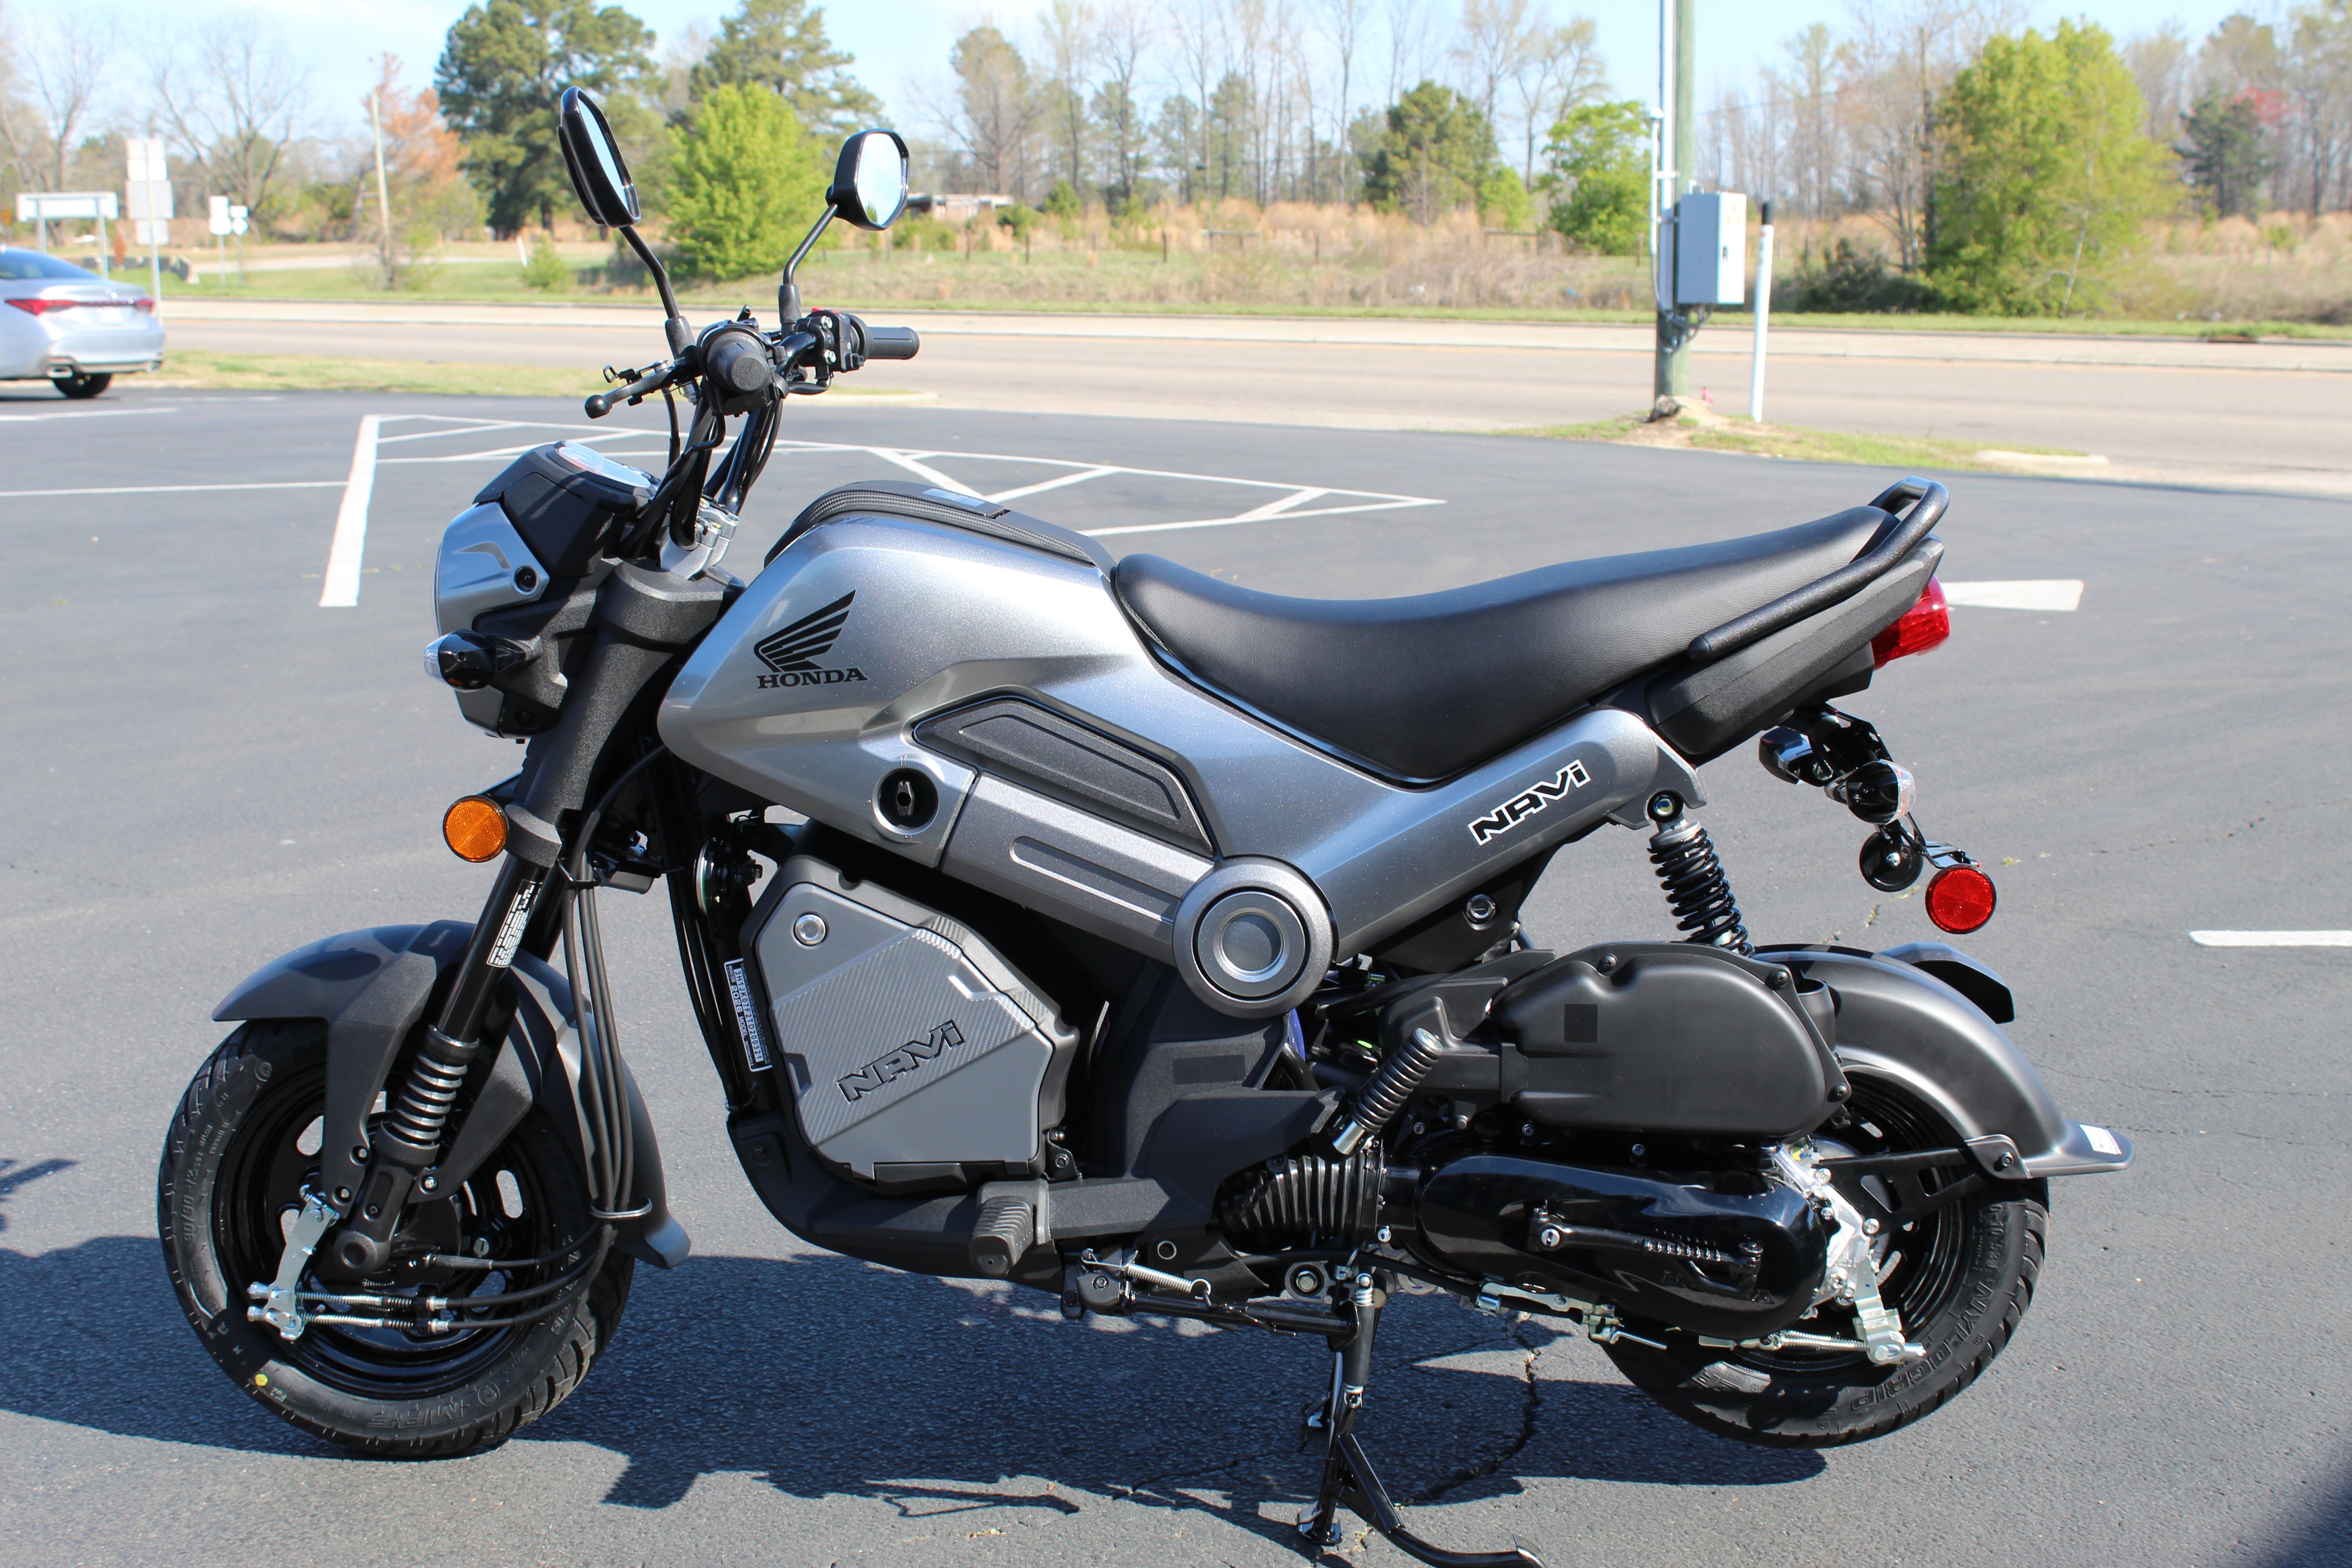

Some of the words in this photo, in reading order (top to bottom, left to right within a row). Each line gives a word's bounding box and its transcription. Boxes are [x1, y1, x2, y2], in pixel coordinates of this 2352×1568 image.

[756, 668, 868, 689] HONDA
[731, 985, 743, 1013] 2026
[739, 1016, 748, 1038] MODEL
[735, 970, 762, 1059] 3H1JK07F2TD200321
[1851, 1281, 1994, 1411] NYLOGRIP
[367, 1399, 464, 1428] MRF
